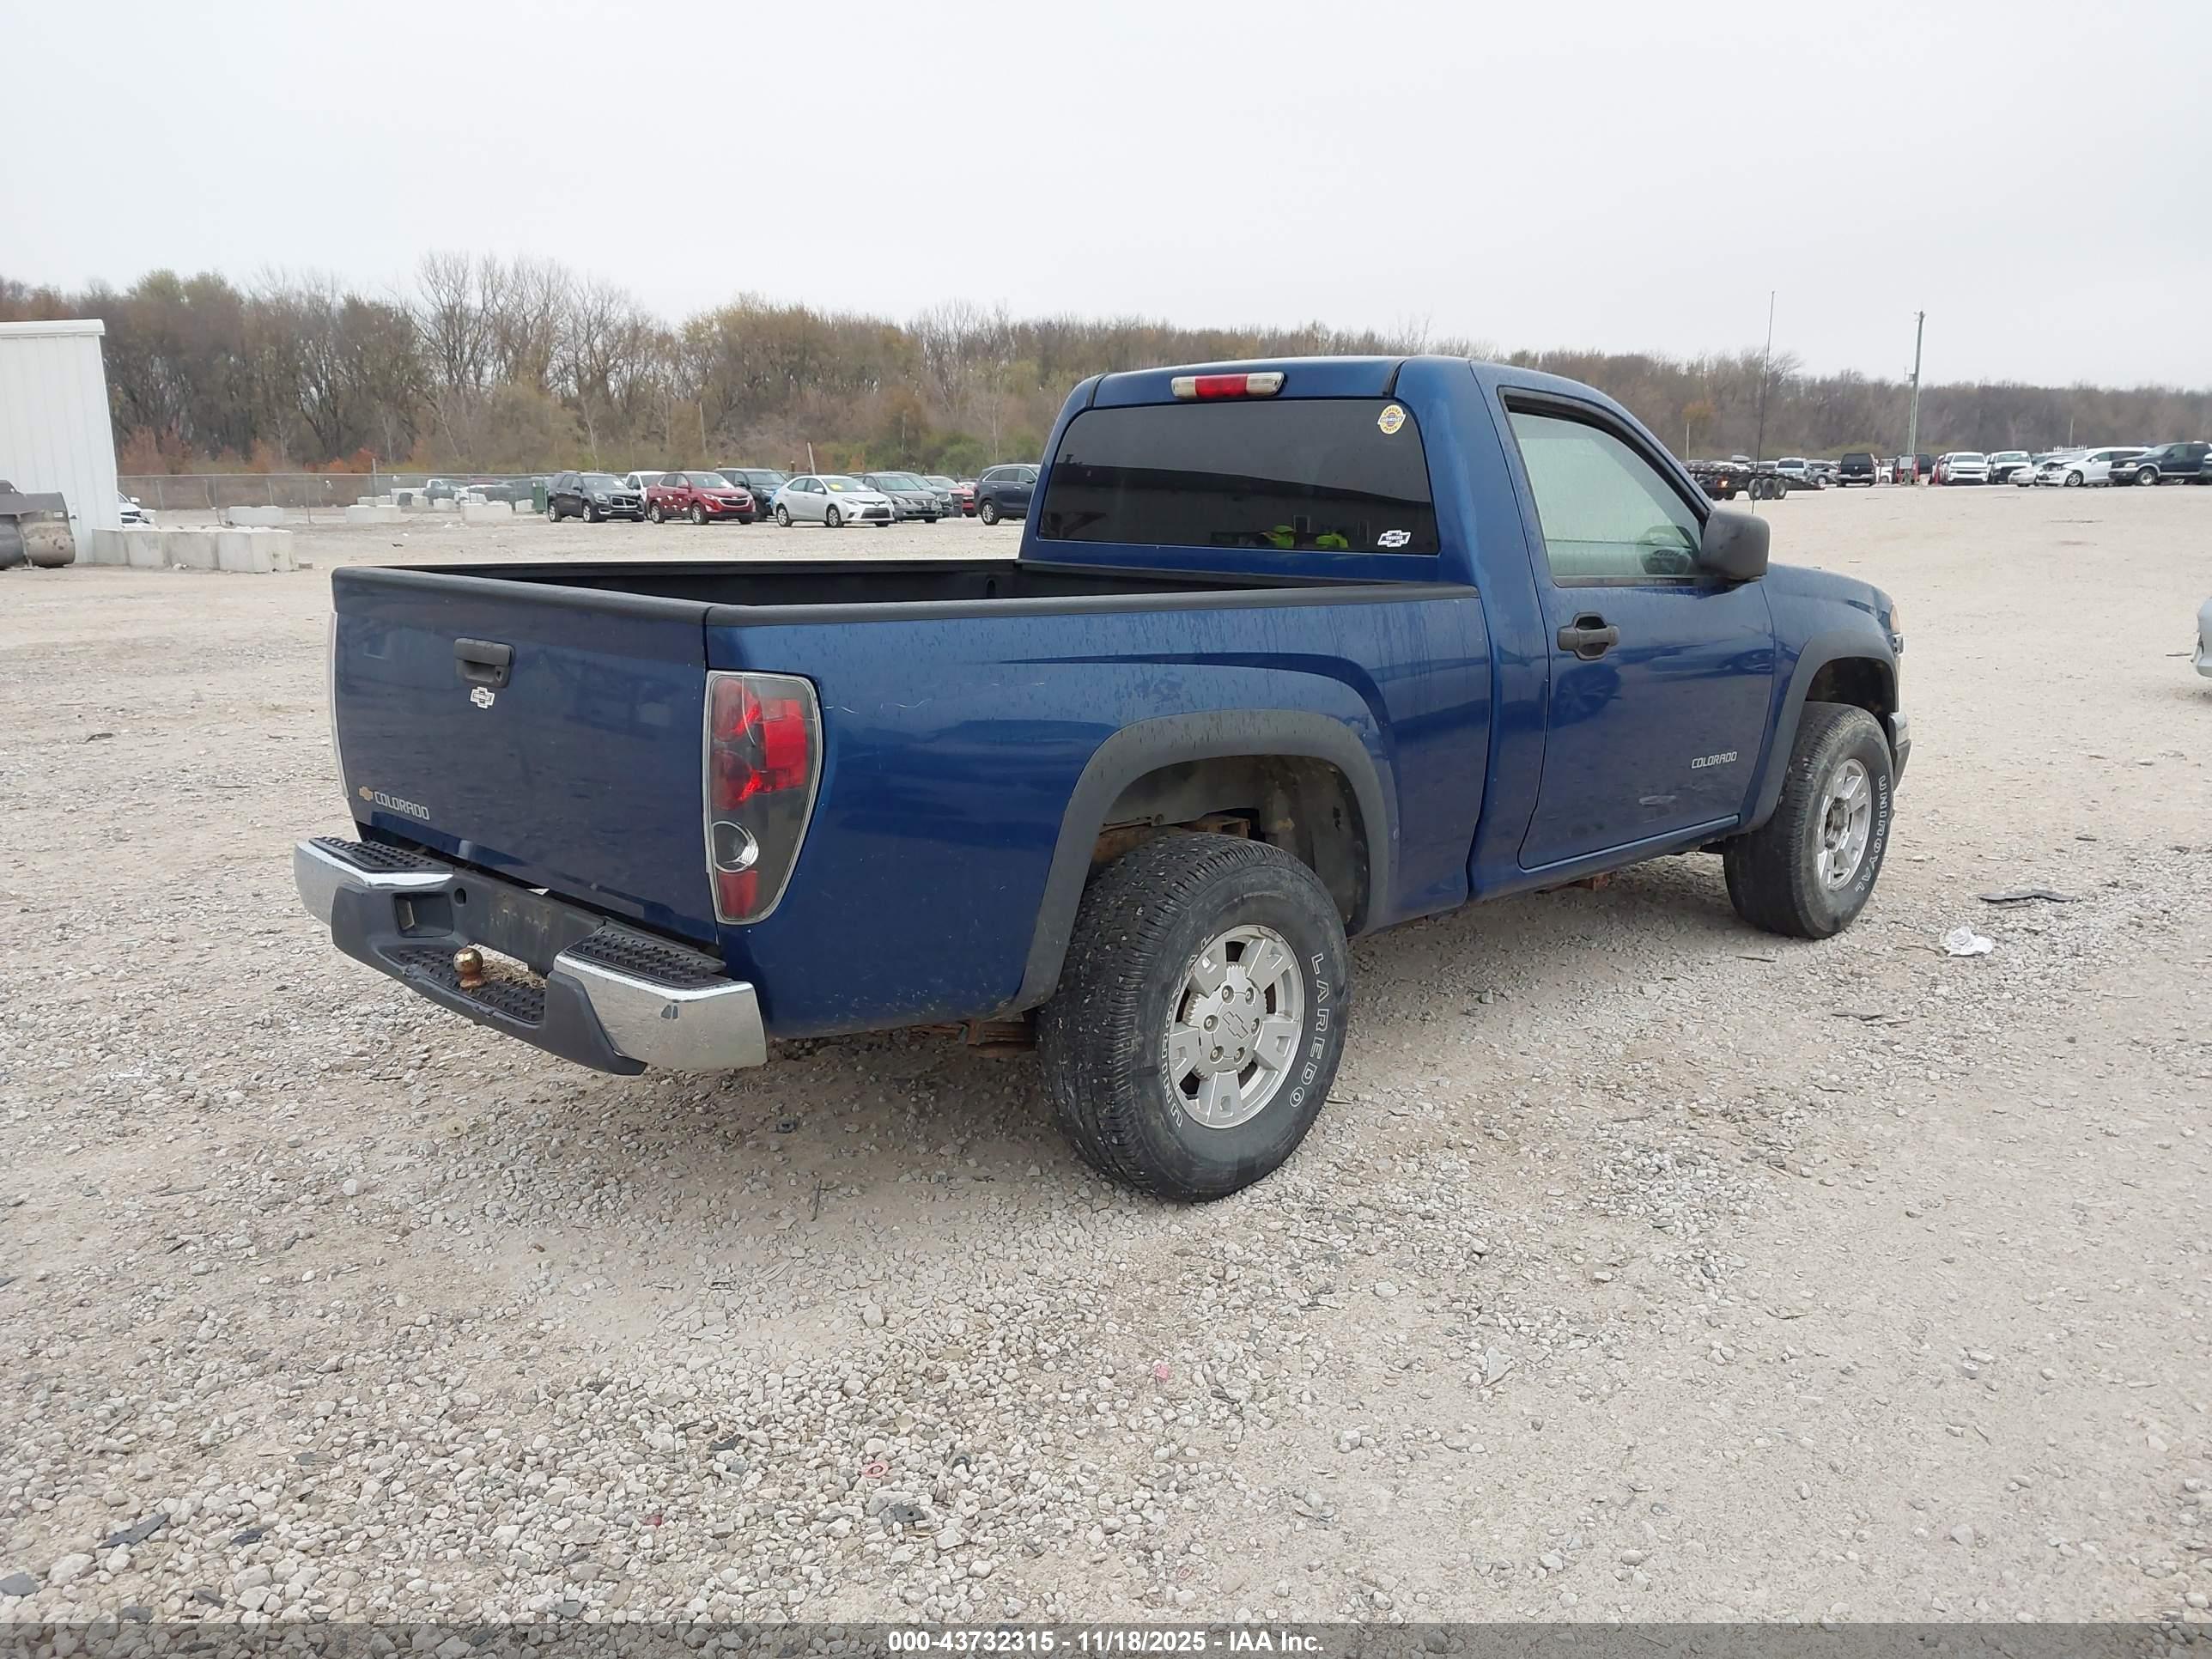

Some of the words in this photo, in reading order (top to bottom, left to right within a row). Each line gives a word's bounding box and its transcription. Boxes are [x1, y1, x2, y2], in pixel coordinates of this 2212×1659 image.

[1691, 751, 1738, 769] COLORADO
[374, 791, 430, 821] COLORADO
[1856, 775, 1887, 892] UNIROYAL
[1290, 952, 1329, 1108] LAREDO
